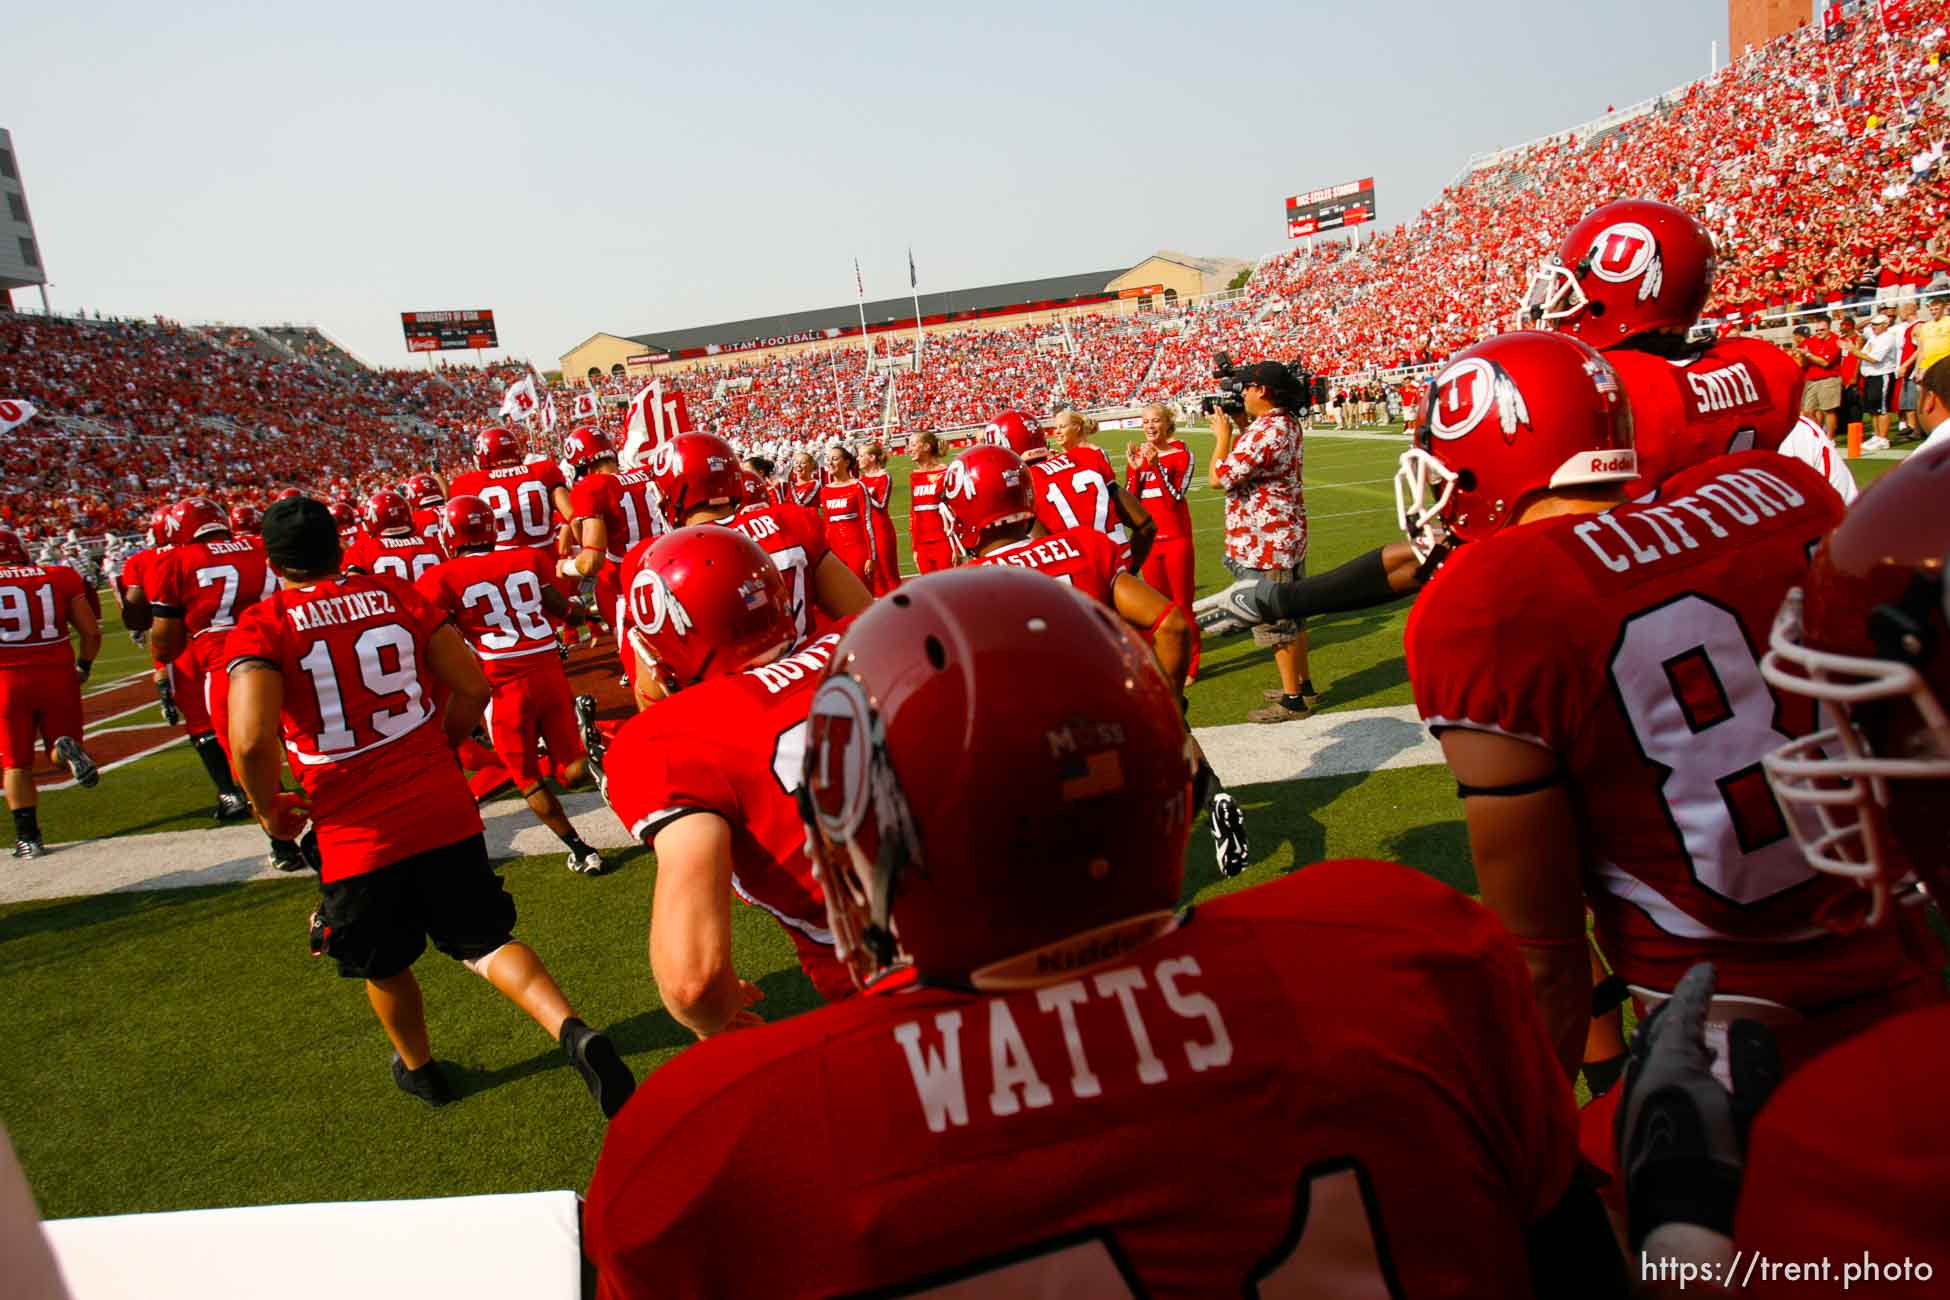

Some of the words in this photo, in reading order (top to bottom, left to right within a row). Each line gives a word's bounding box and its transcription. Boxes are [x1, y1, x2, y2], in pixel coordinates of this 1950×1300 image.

[722, 340, 756, 353] UTAH
[760, 332, 822, 348] FOOTBALL
[1687, 362, 1759, 413] SMITH
[913, 483, 937, 496] UTAH
[1039, 455, 1076, 476] DALE
[479, 480, 552, 542] 80
[736, 514, 781, 543] LOR
[1045, 468, 1128, 545] 12
[1573, 467, 1805, 573] CLIFFORD
[0, 583, 59, 642] 91
[287, 589, 397, 632] MARTINEZ
[462, 569, 553, 650] 38
[300, 623, 425, 753] 19
[894, 954, 1234, 1133] WATTS
